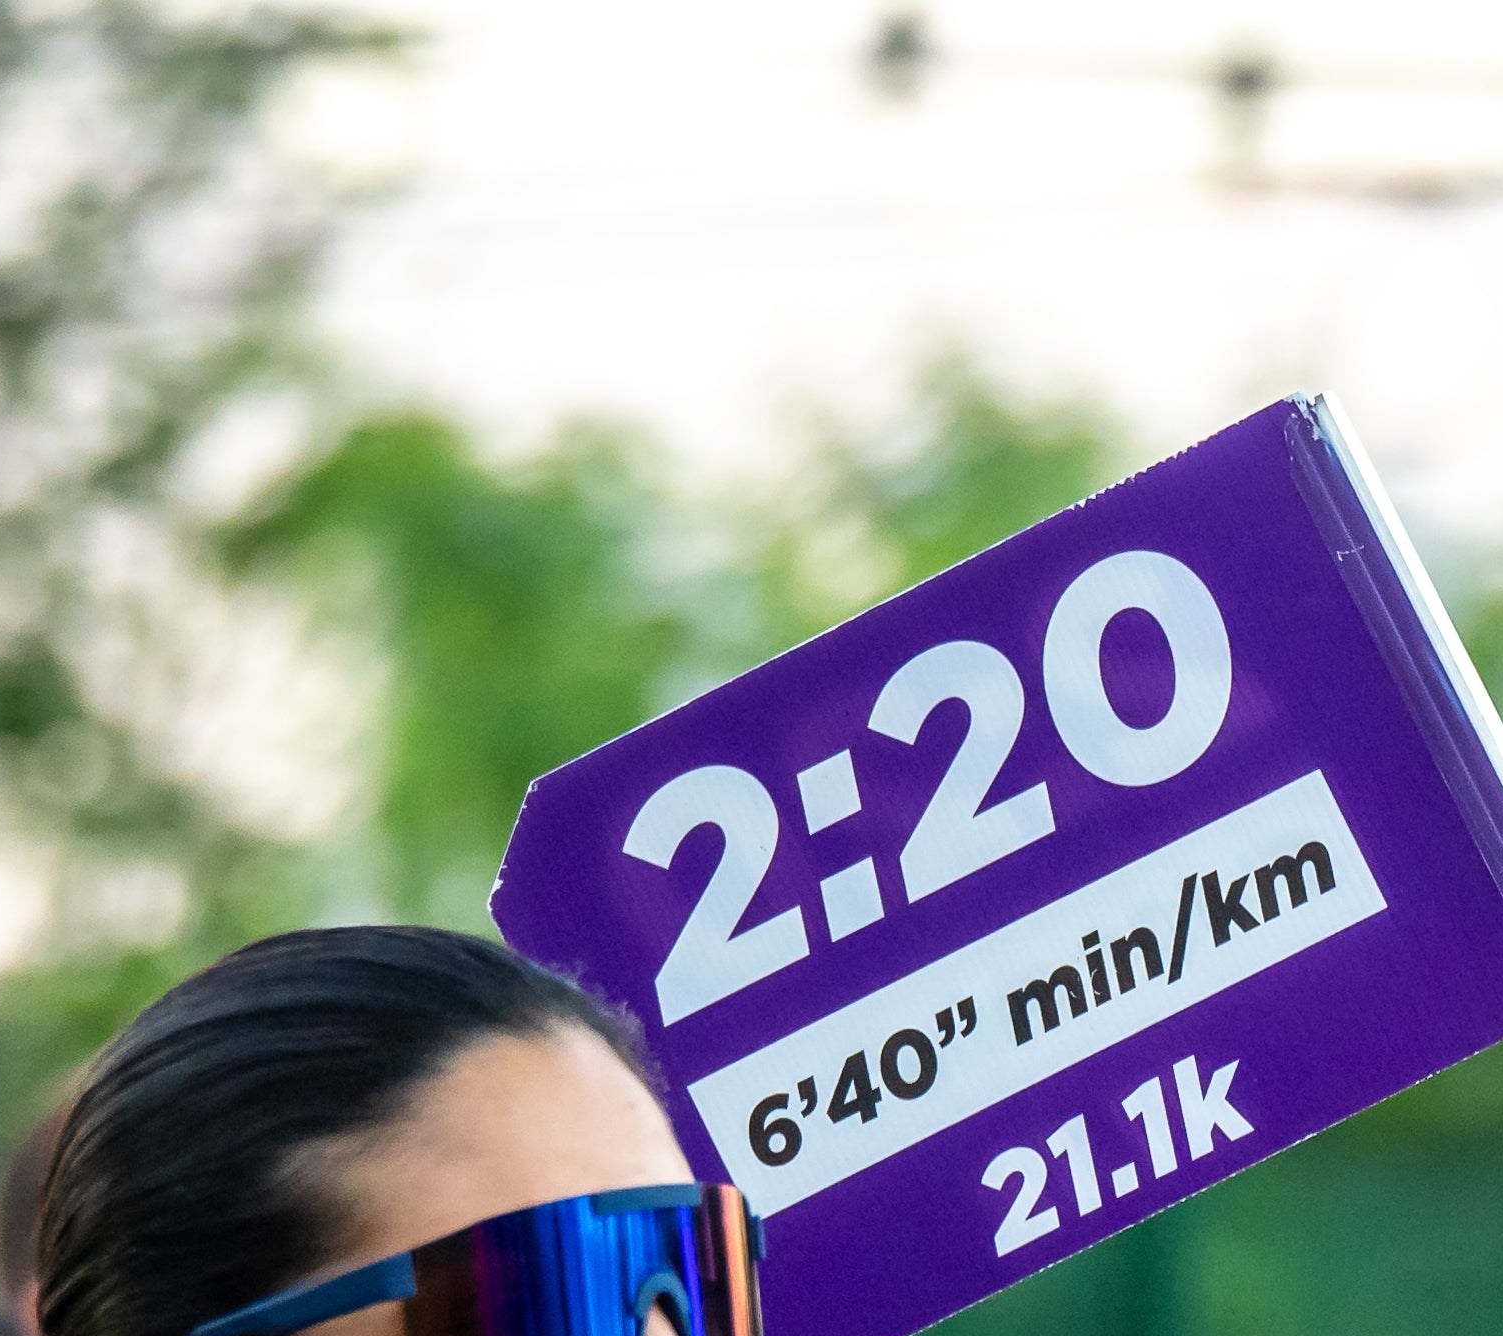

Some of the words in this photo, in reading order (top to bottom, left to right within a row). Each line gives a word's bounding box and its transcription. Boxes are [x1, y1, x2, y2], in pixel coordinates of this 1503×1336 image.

[622, 550, 1233, 1027] 2:20
[1008, 838, 1336, 1046] min/km
[980, 1053, 1255, 1258] 21.1k
